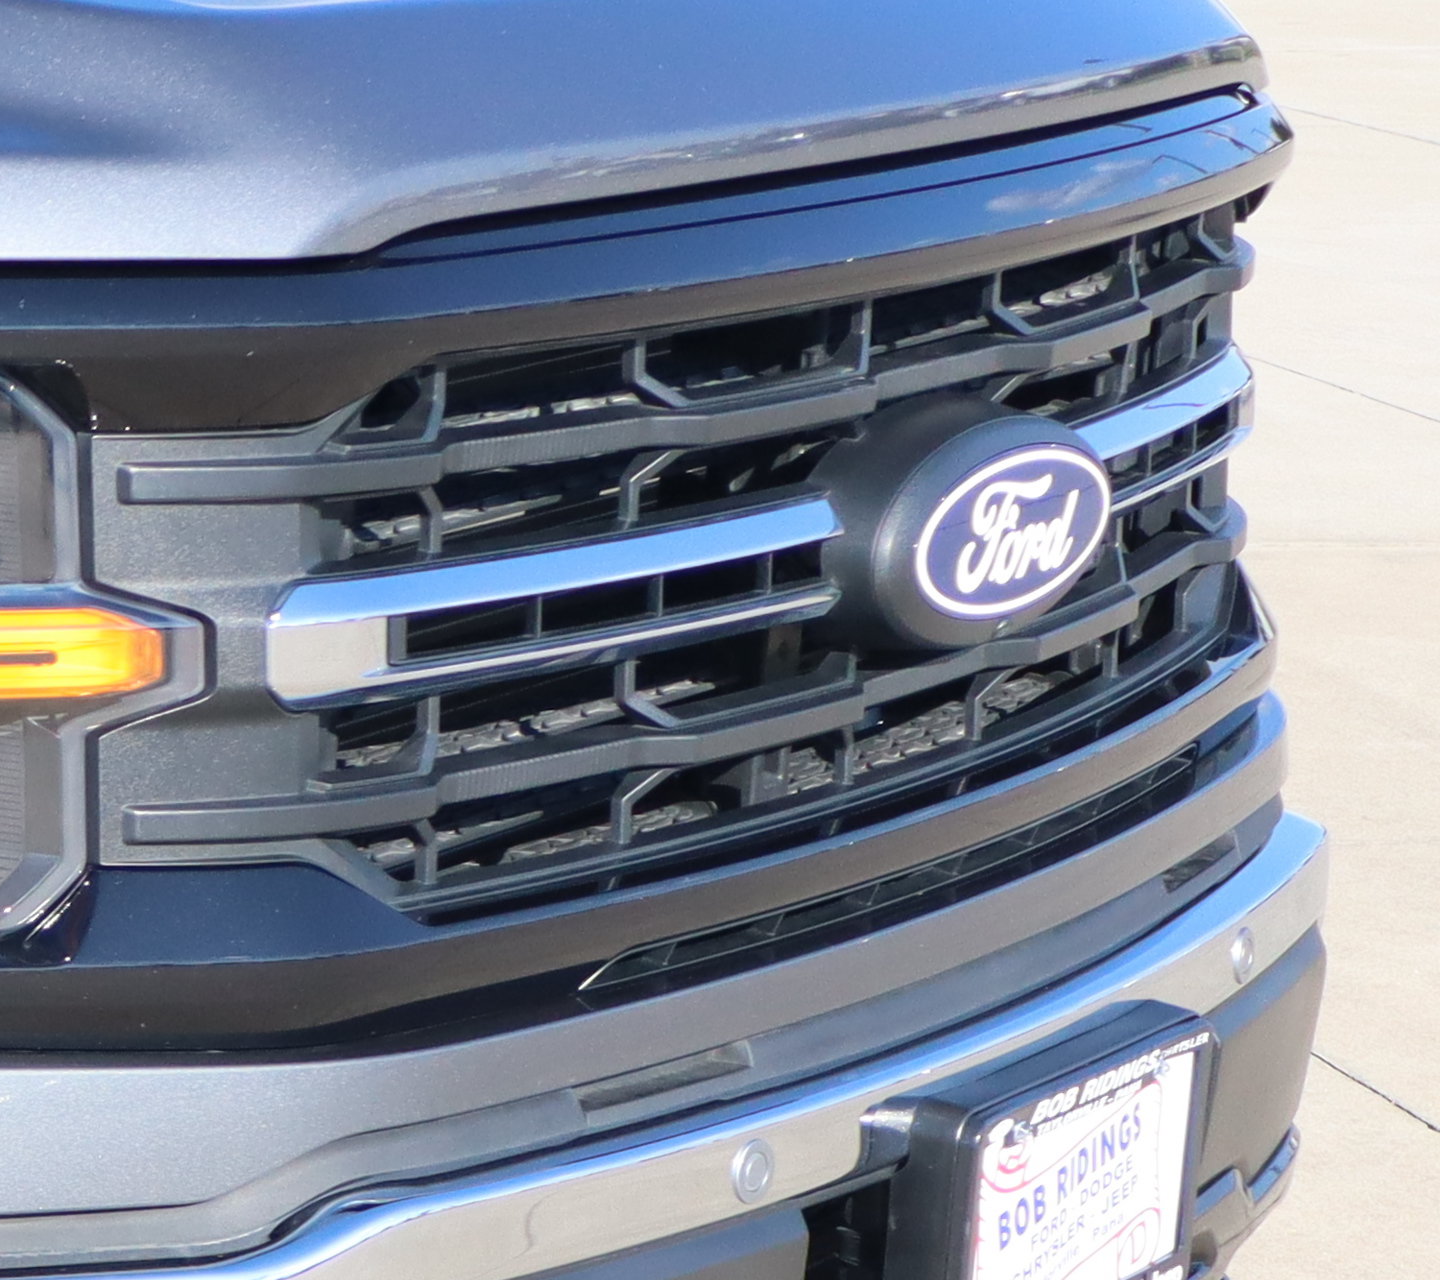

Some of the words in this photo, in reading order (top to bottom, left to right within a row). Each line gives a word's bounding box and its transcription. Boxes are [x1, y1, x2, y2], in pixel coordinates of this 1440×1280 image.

[956, 473, 1080, 594] Ford
[1030, 1087, 1079, 1125] BOB
[1079, 1049, 1161, 1104] RIDINGS
[999, 1184, 1046, 1251] BOB
[1057, 1102, 1141, 1206] RIDINGS
[1031, 1208, 1068, 1252] FORD
[1080, 1155, 1133, 1207] DODGE
[1101, 1174, 1139, 1214] JEEP
